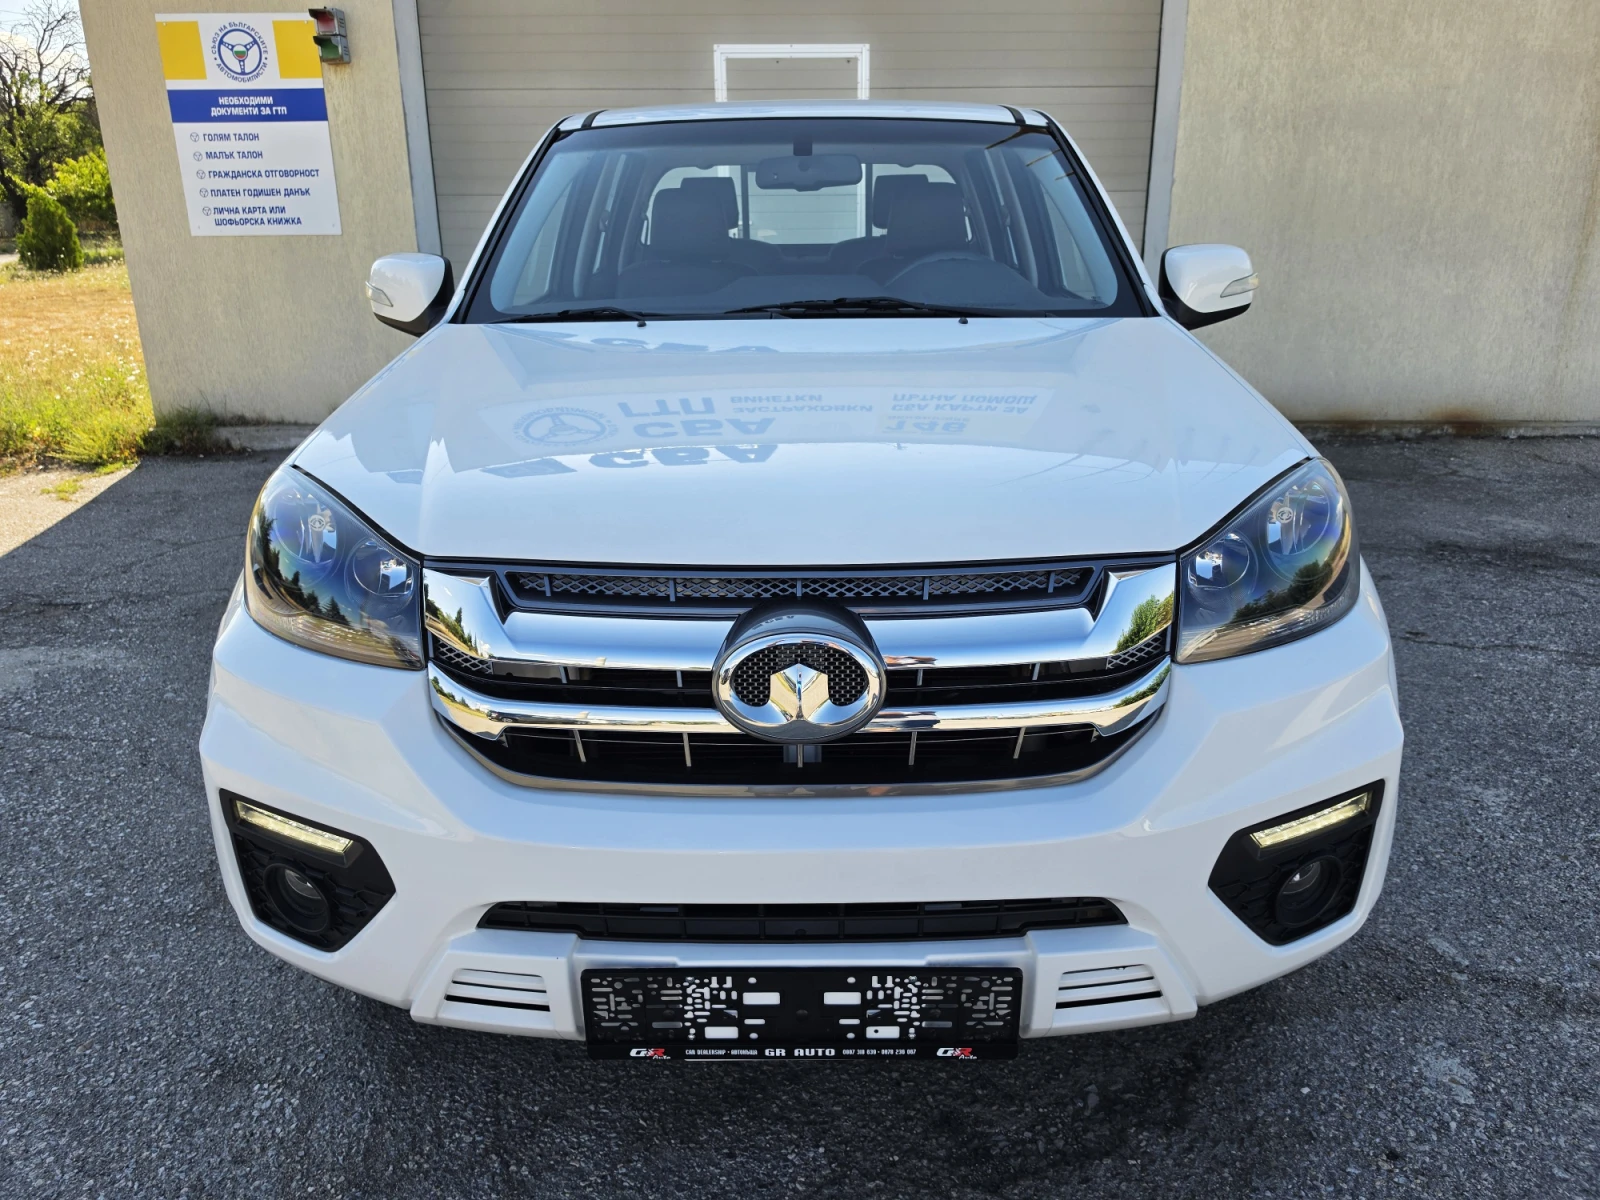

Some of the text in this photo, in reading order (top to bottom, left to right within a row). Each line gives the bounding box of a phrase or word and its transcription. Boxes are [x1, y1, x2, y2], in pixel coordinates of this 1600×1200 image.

[211, 22, 268, 55] СЪЮЗ НА БЪЛГАРСКИТЕ
[216, 62, 268, 83] АВТОМОБИЛИСТИ
[218, 96, 274, 106] НЕОБХОДИМИ
[211, 106, 287, 117] ДОКУМЕНТИ ЗА ГТП
[203, 133, 260, 142] ГОЛЯМ ТАЛОН
[205, 151, 263, 160] МАЛЪК ТАЛОН
[208, 168, 319, 180] ГРАЖДАНСКА ОТГОВОРНОСТ
[210, 188, 311, 198] ПЛАТЕН ГОДИШЕН ДАНЪК
[213, 206, 286, 215] ЛИЧНА КАРТА ИЛИ
[214, 217, 302, 226] ШОФЬОРСКА КНИЖКА
[764, 1048, 836, 1057] GR AUTO
